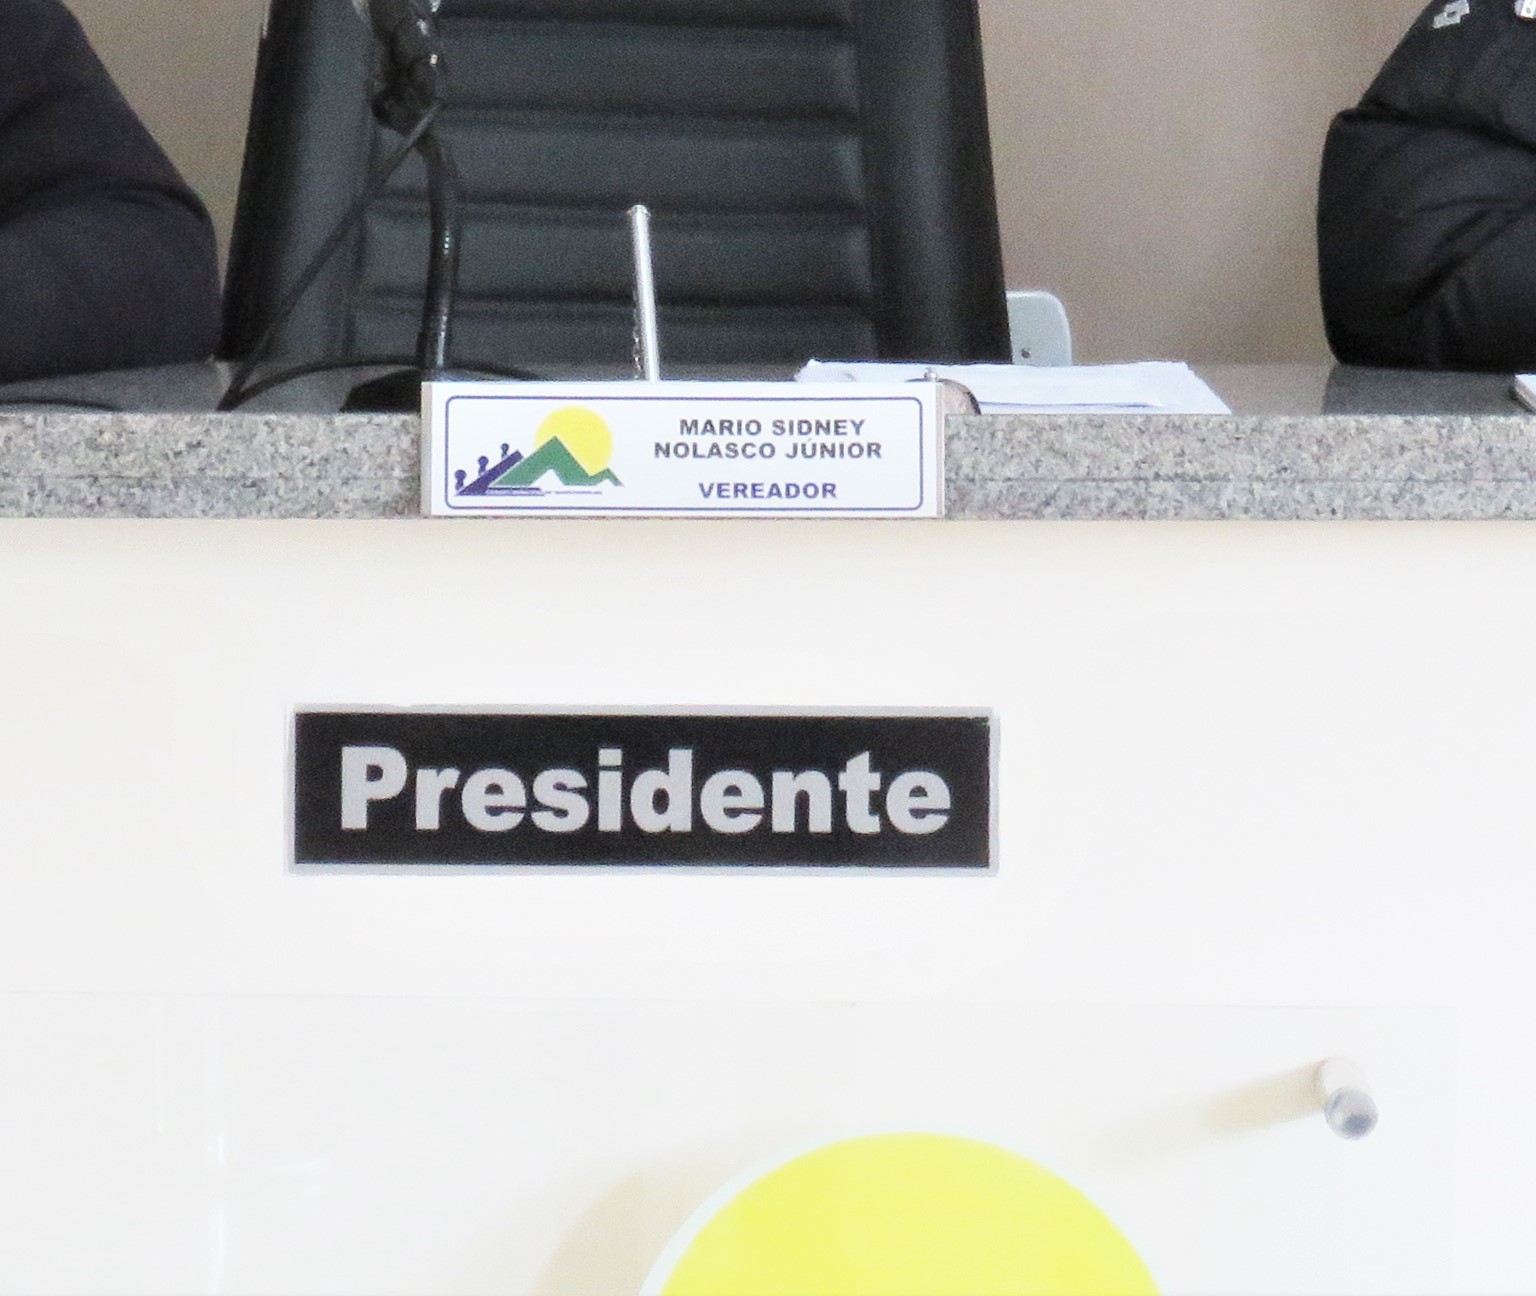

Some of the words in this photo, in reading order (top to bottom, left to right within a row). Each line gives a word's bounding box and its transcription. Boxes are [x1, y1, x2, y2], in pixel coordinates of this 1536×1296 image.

[679, 419, 762, 436] MARIO
[772, 419, 865, 436] SIDNEY
[654, 441, 776, 459] NOLASCO
[785, 437, 882, 460] JÚNIOR
[698, 482, 837, 500] VEREADOR
[340, 745, 952, 835] Presidente
